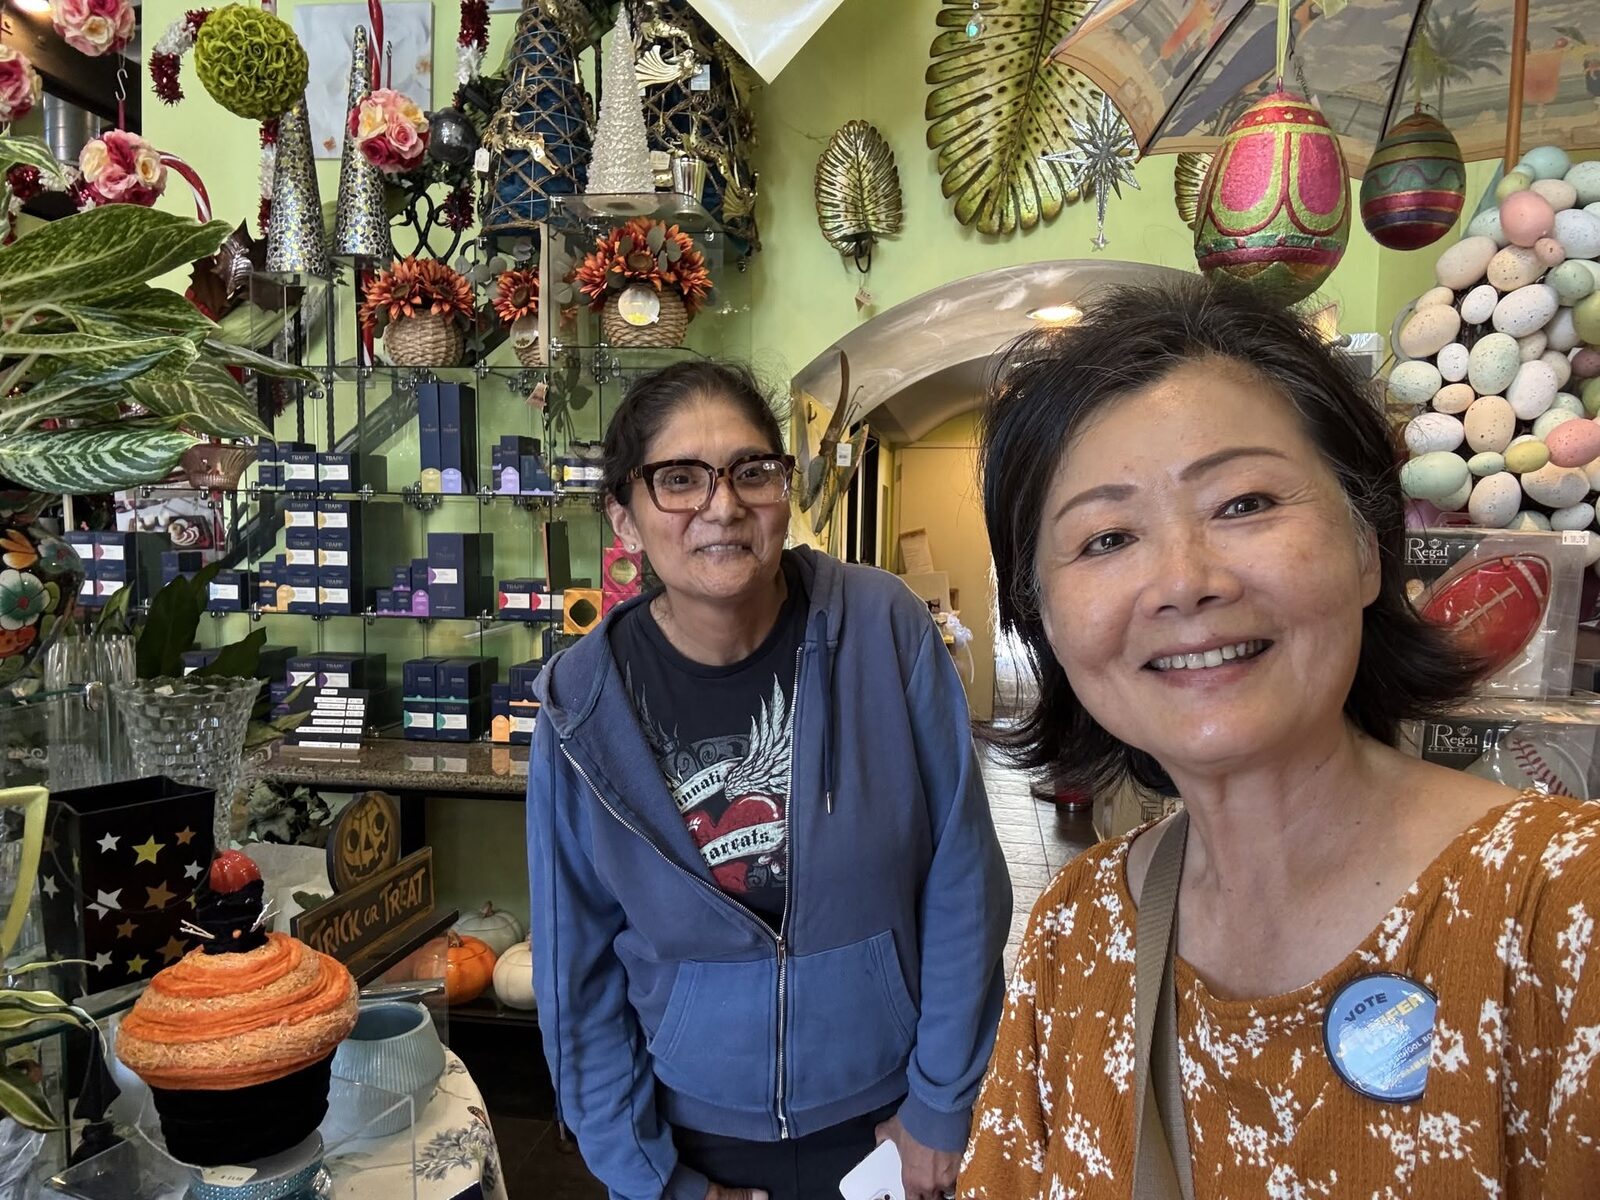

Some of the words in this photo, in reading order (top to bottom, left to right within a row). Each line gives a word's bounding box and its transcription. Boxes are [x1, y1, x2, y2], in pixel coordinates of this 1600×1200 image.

[1404, 537, 1449, 560] Regal
[1428, 723, 1478, 749] Regal
[674, 769, 722, 807] innati
[701, 828, 770, 866] arcats
[309, 908, 363, 954] TRICK
[363, 904, 380, 927] OR
[379, 867, 426, 924] TREAT
[1343, 991, 1389, 1023] VOTE
